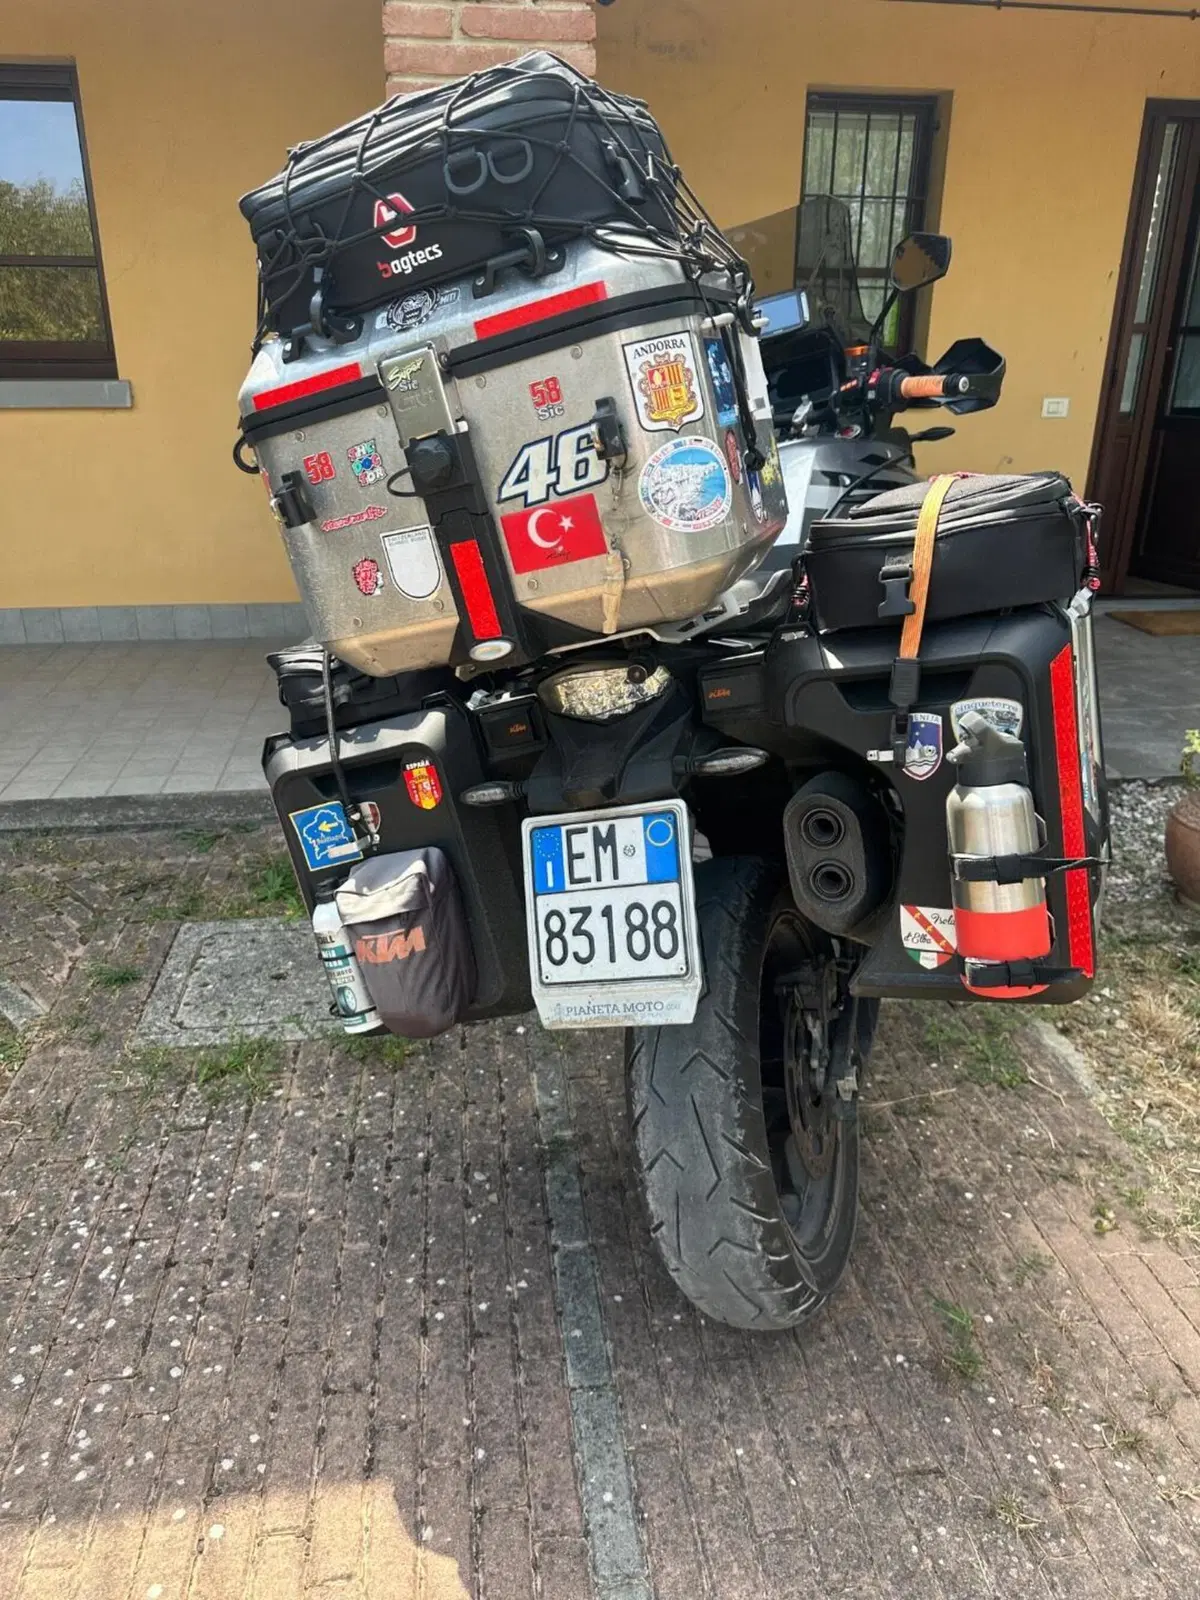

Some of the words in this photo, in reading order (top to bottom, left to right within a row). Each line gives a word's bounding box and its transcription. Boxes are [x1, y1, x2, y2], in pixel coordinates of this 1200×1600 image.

[376, 243, 443, 278] bagtecs
[633, 338, 686, 359] ANDORRA
[528, 376, 563, 409] 58
[537, 404, 564, 421] Sic
[302, 450, 336, 486] 58
[496, 419, 610, 508] 46
[708, 688, 731, 699] KTM
[405, 758, 430, 771] ESPAÑA
[565, 823, 619, 885] EM
[356, 926, 426, 964] KTM
[543, 899, 679, 967] 83188
[566, 1002, 620, 1018] PIANETA
[623, 1000, 664, 1013] MOTO
